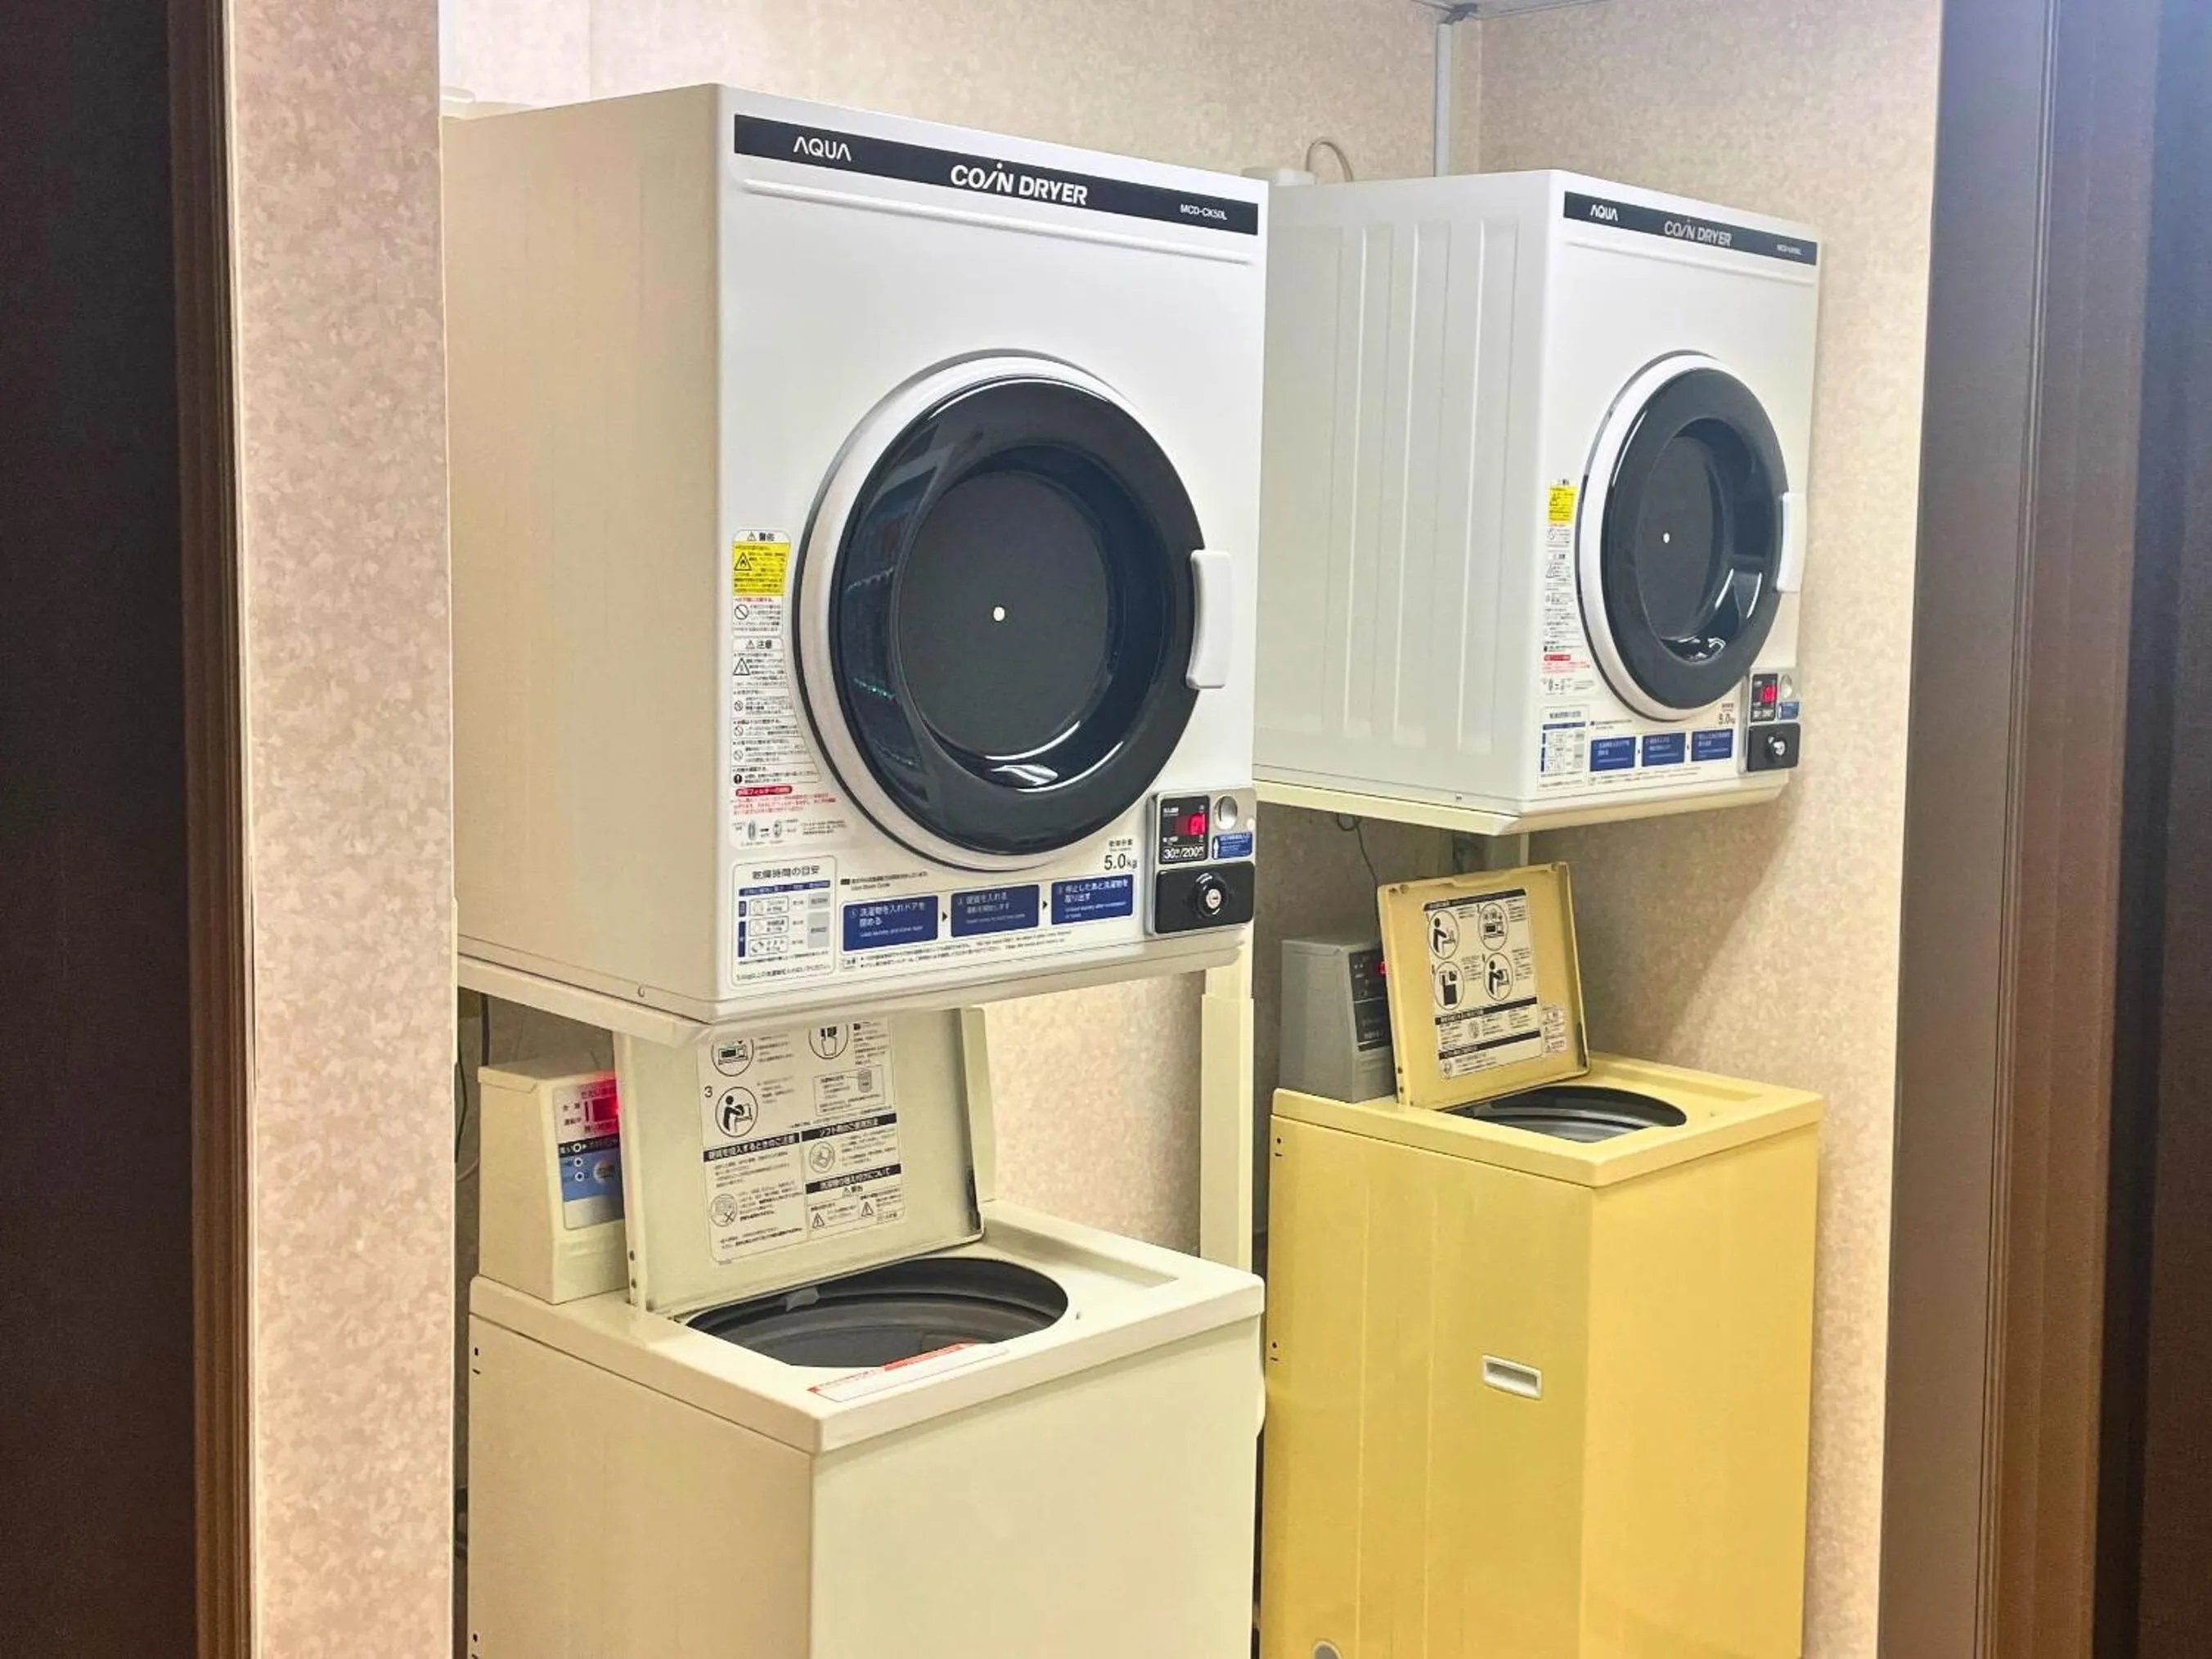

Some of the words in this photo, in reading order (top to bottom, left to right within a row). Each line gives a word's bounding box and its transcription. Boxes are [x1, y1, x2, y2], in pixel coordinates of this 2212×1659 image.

[793, 136, 852, 161] AQUA
[1018, 174, 1088, 205] DRYER
[1589, 205, 1619, 222] AQUA
[1697, 227, 1733, 247] DRYER
[704, 1085, 713, 1098] 3
